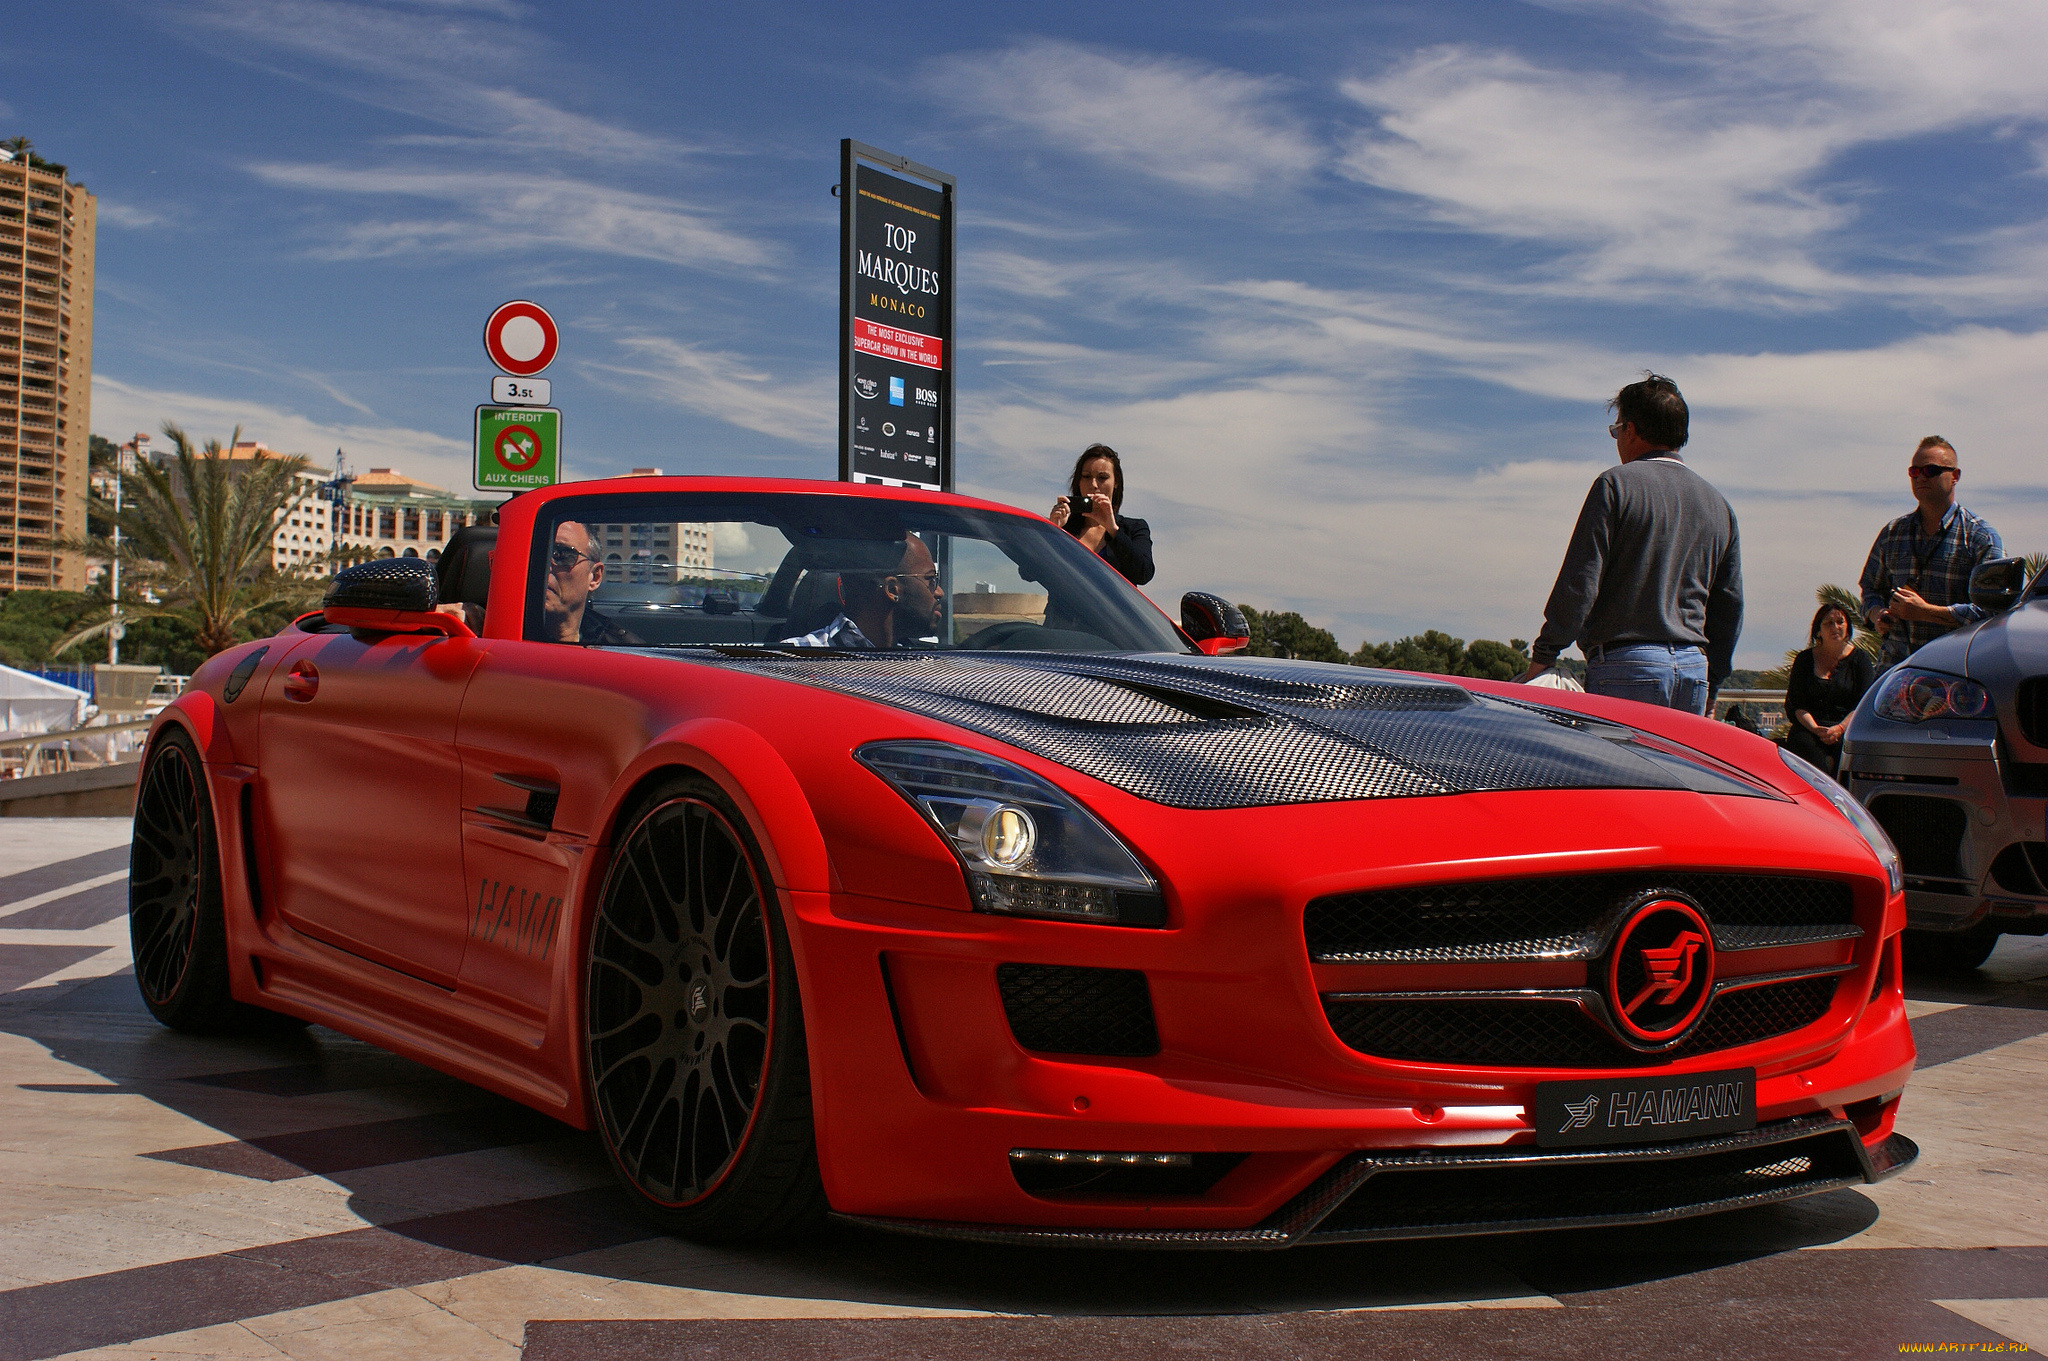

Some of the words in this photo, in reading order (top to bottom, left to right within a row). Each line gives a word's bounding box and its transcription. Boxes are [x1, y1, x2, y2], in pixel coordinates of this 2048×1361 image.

[884, 222, 917, 254] TOP
[857, 249, 939, 295] MARQUES
[870, 293, 925, 318] MONACO
[867, 324, 877, 337] THE
[879, 327, 894, 340] MOST
[895, 332, 924, 348] EXCLUSIVE
[854, 335, 881, 352] SUPERCAR
[882, 343, 898, 356] SHOW
[900, 347, 906, 358] IN
[907, 349, 918, 361] THE
[919, 352, 938, 365] WORLD
[916, 387, 938, 404] BOSS
[495, 412, 543, 422] INTERDIT
[485, 473, 507, 483] AUX
[510, 474, 550, 484] CHIENS
[1607, 1081, 1744, 1128] HAMANN
